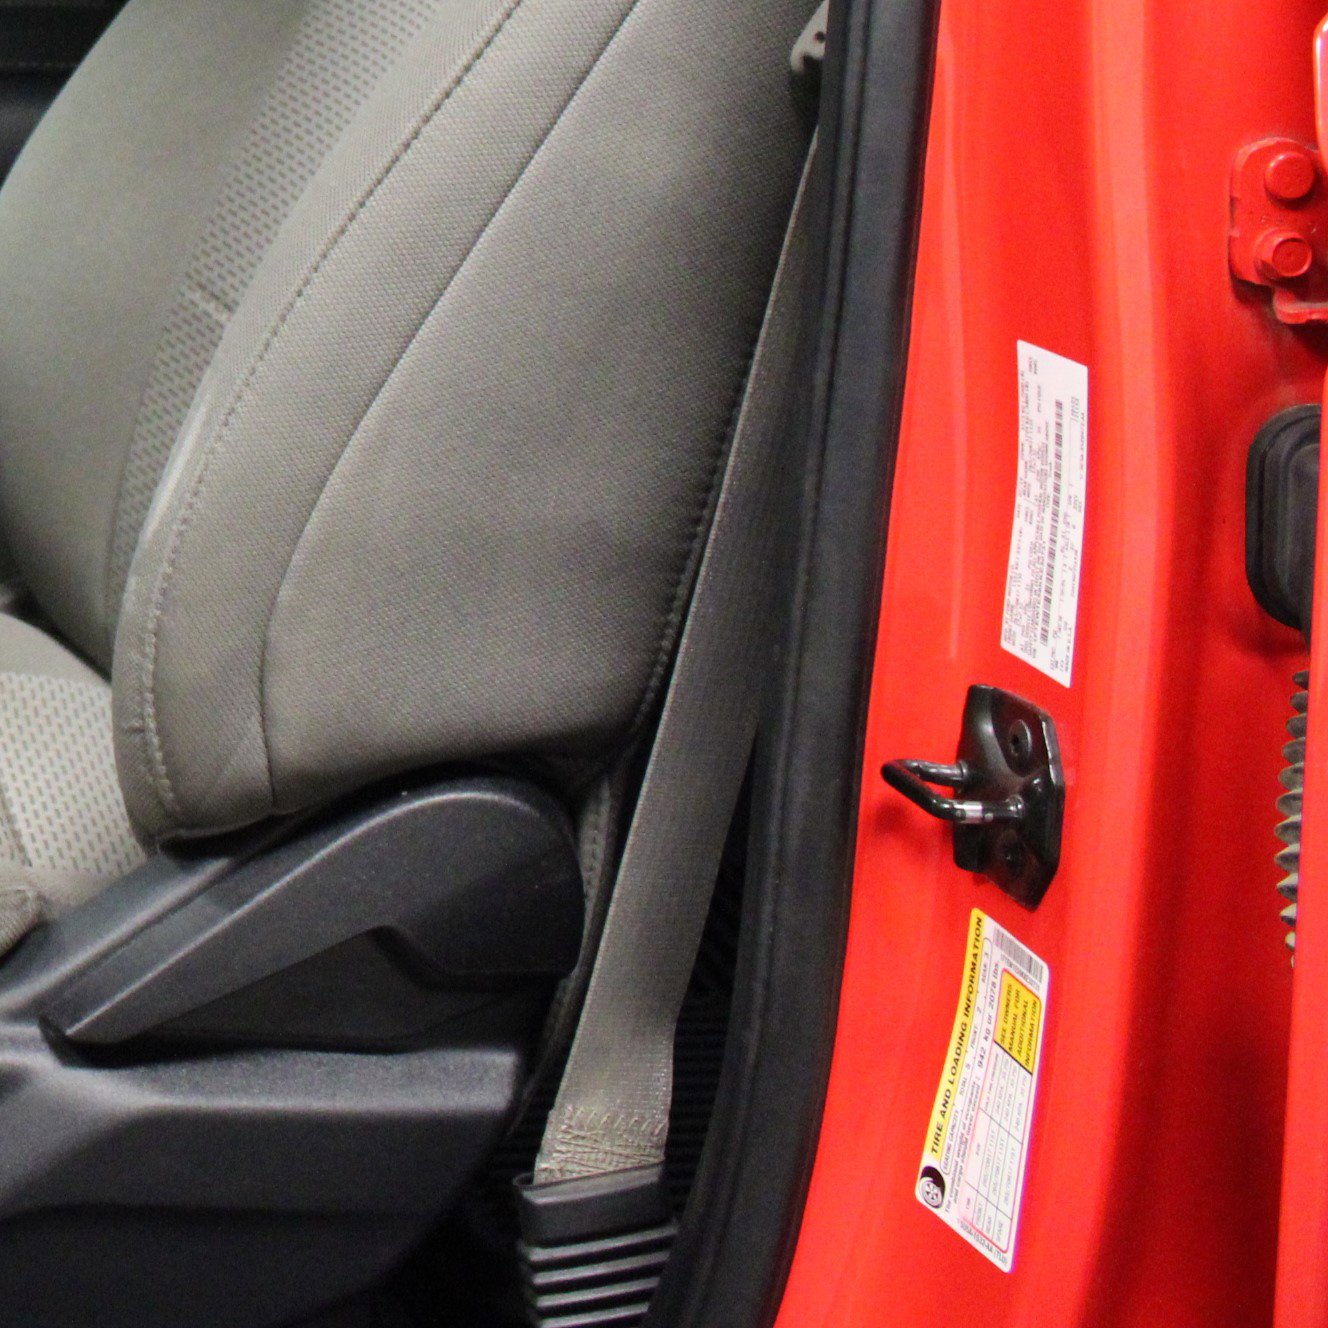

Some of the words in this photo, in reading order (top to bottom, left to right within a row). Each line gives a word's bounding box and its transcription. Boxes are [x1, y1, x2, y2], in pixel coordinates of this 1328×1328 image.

[988, 981, 996, 1010] 2078
[931, 1122, 943, 1154] TIRE
[939, 1088, 952, 1119] AND
[948, 1022, 967, 1085] LOADING
[963, 916, 982, 1018] INFORMATION
[983, 1027, 990, 1042] kg
[987, 1014, 992, 1025] or
[1008, 1013, 1018, 1052] MANUAL
[1017, 1000, 1028, 1057] ADDITIONAL
[1024, 999, 1037, 1067] INFORMATION
[977, 1046, 986, 1068] 942
